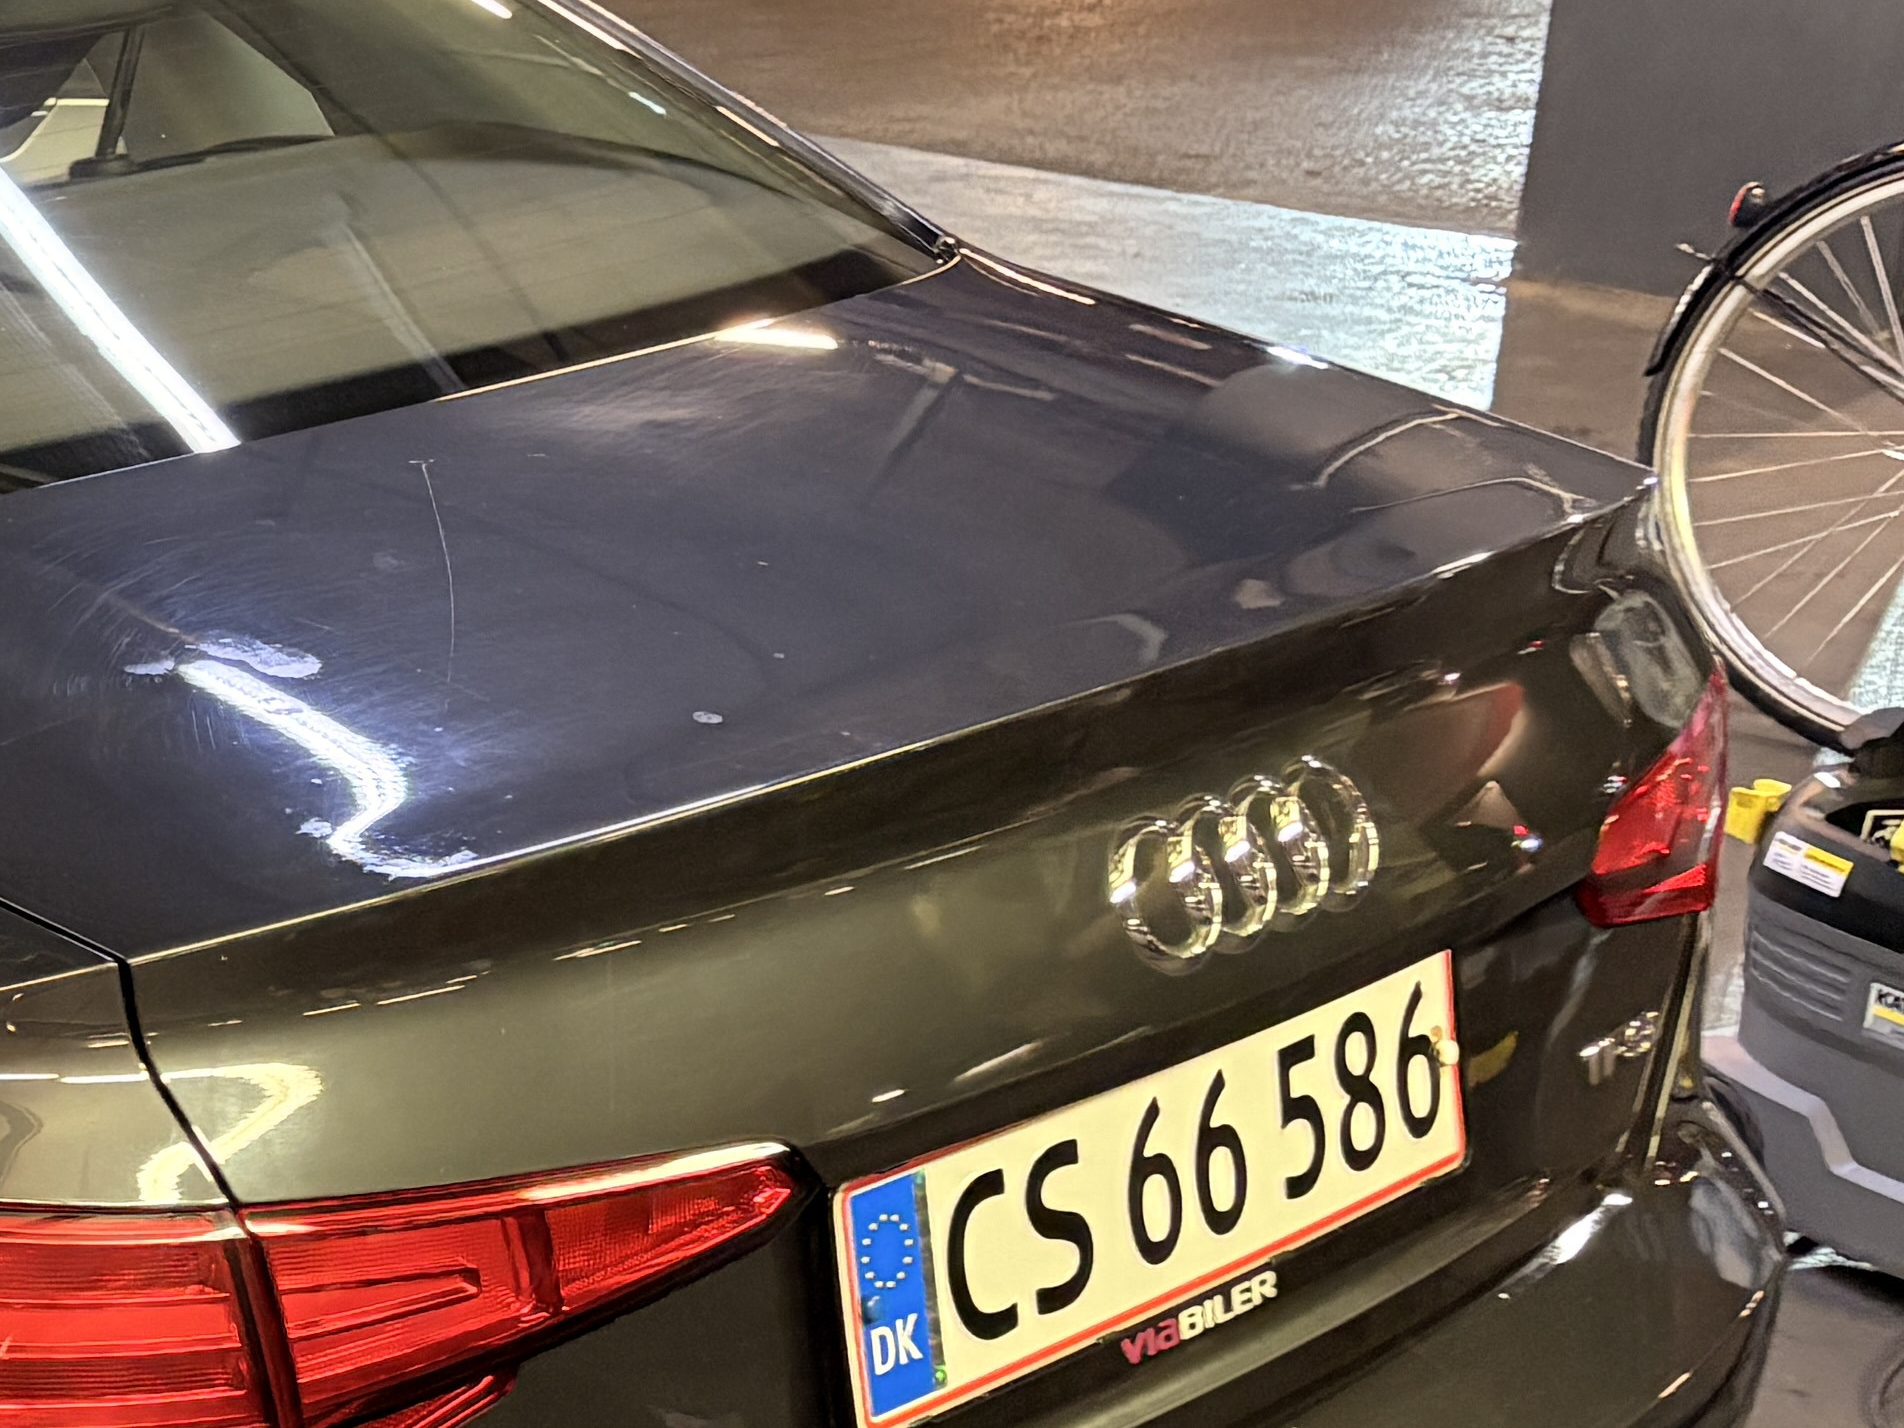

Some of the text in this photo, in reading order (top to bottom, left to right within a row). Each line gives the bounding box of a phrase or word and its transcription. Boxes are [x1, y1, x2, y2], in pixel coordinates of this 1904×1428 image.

[946, 980, 1442, 1341] CS 66 586
[871, 1312, 925, 1376] DK
